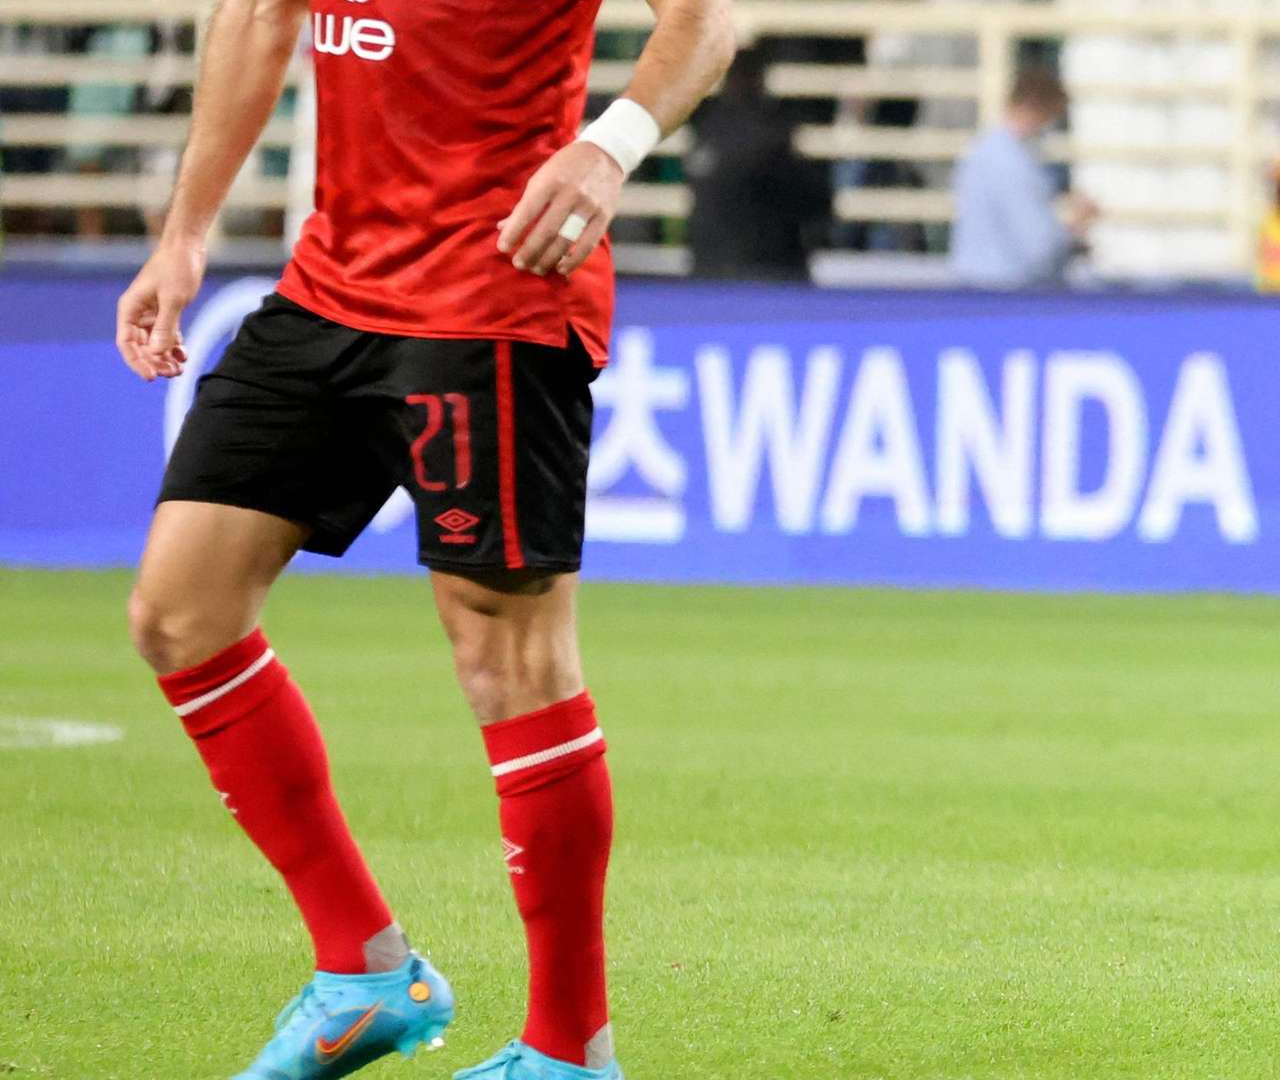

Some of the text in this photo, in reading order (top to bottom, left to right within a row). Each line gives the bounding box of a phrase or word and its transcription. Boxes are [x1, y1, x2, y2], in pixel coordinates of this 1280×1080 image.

[313, 11, 397, 62] we
[404, 391, 473, 492] 21
[694, 344, 1259, 544] WANDA
